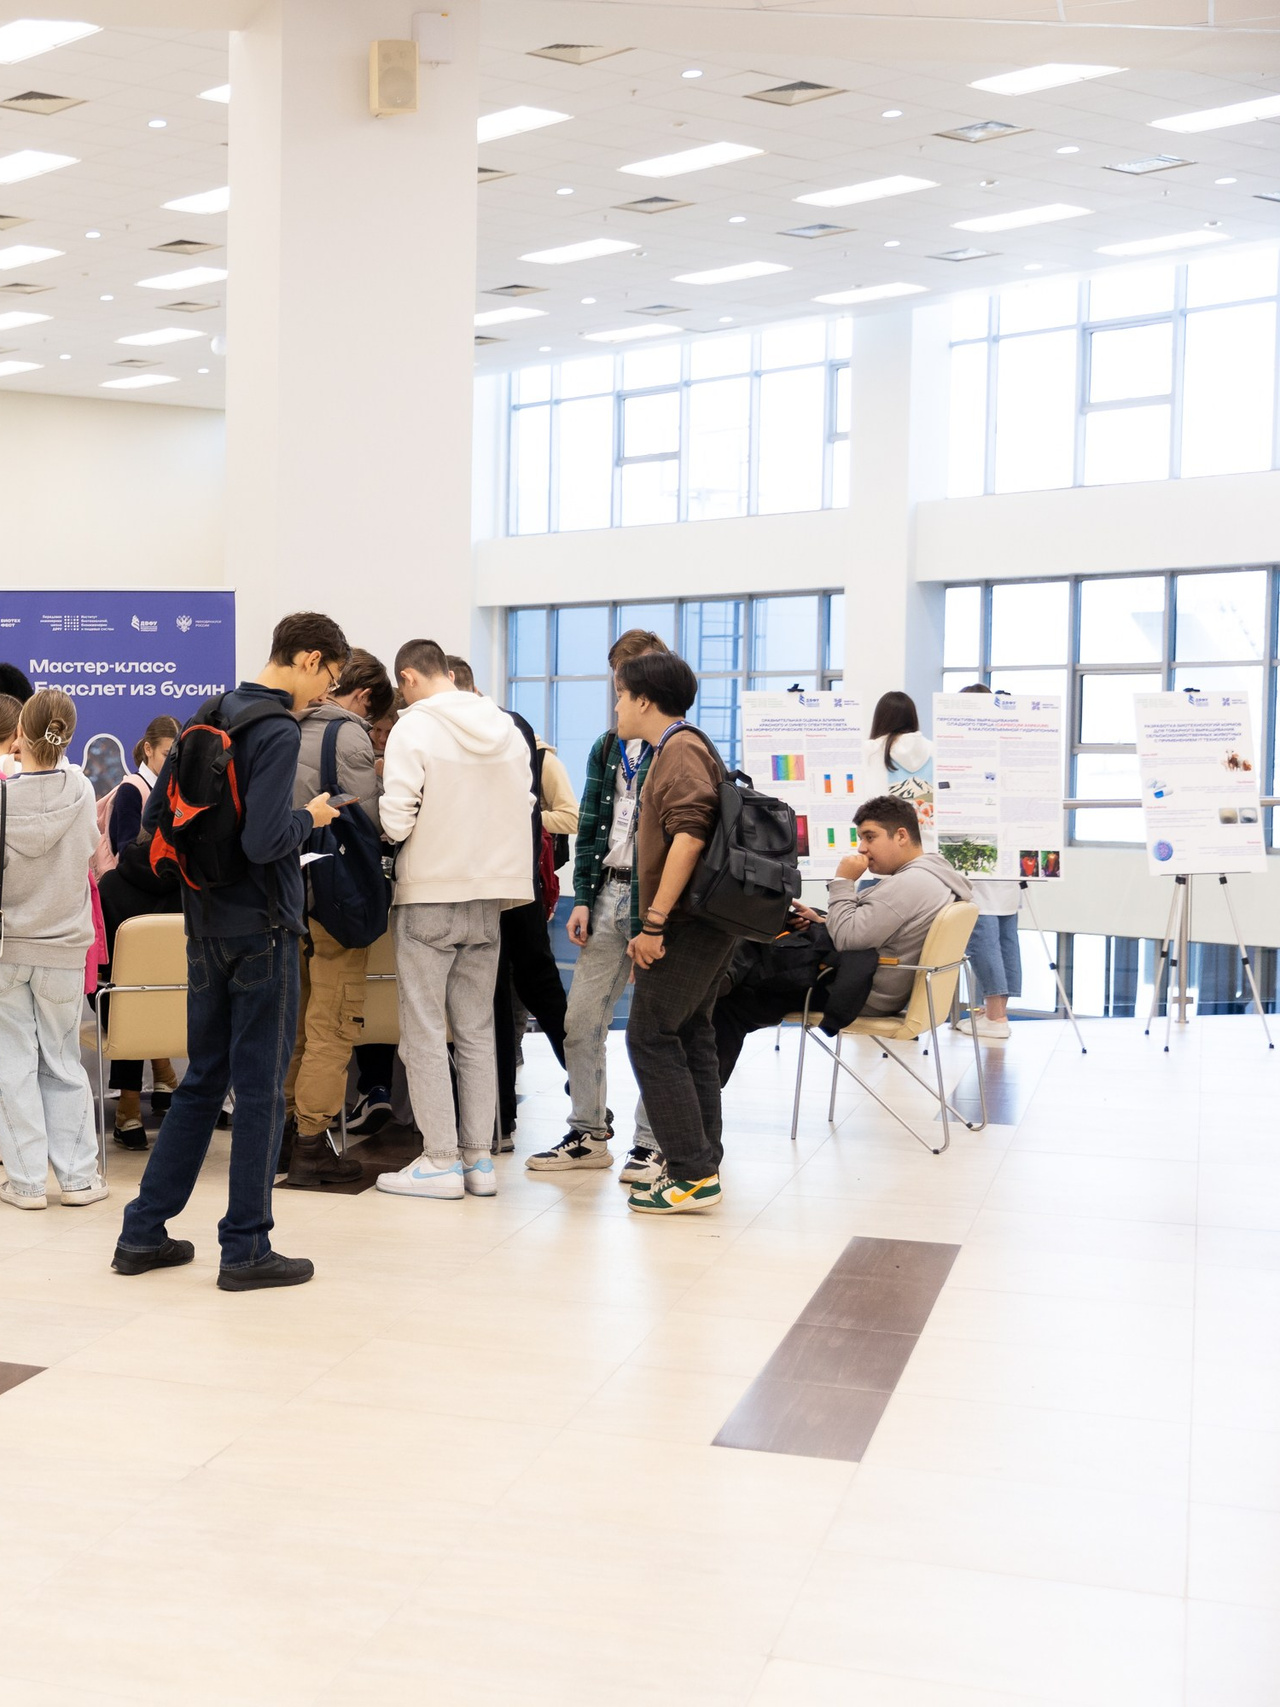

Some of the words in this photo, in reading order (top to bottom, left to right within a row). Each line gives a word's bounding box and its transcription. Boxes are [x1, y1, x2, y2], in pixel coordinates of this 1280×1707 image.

[29, 659, 177, 676] Мастер-класс
[130, 684, 156, 696] из
[160, 680, 225, 699] бусин
